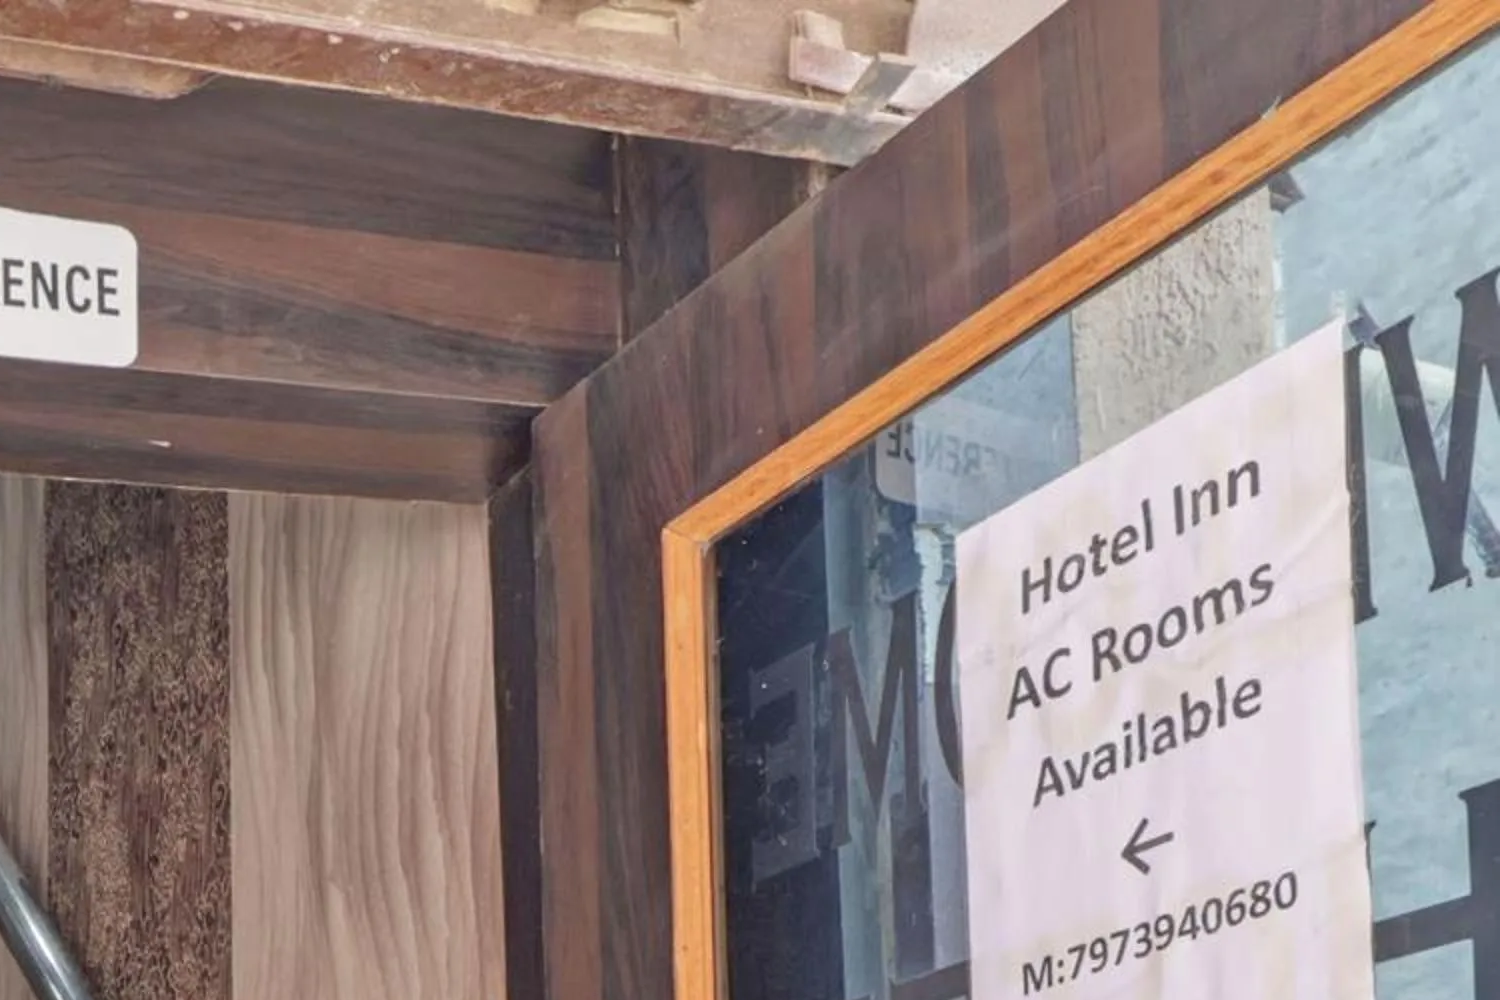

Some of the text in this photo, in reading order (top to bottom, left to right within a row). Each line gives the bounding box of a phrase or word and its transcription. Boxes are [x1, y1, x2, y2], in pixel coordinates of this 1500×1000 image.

[1021, 460, 1260, 615] Hotel Inn
[1006, 563, 1274, 721] AC Rooms
[1033, 677, 1262, 808] Available
[1022, 871, 1297, 996] M:7973940680
